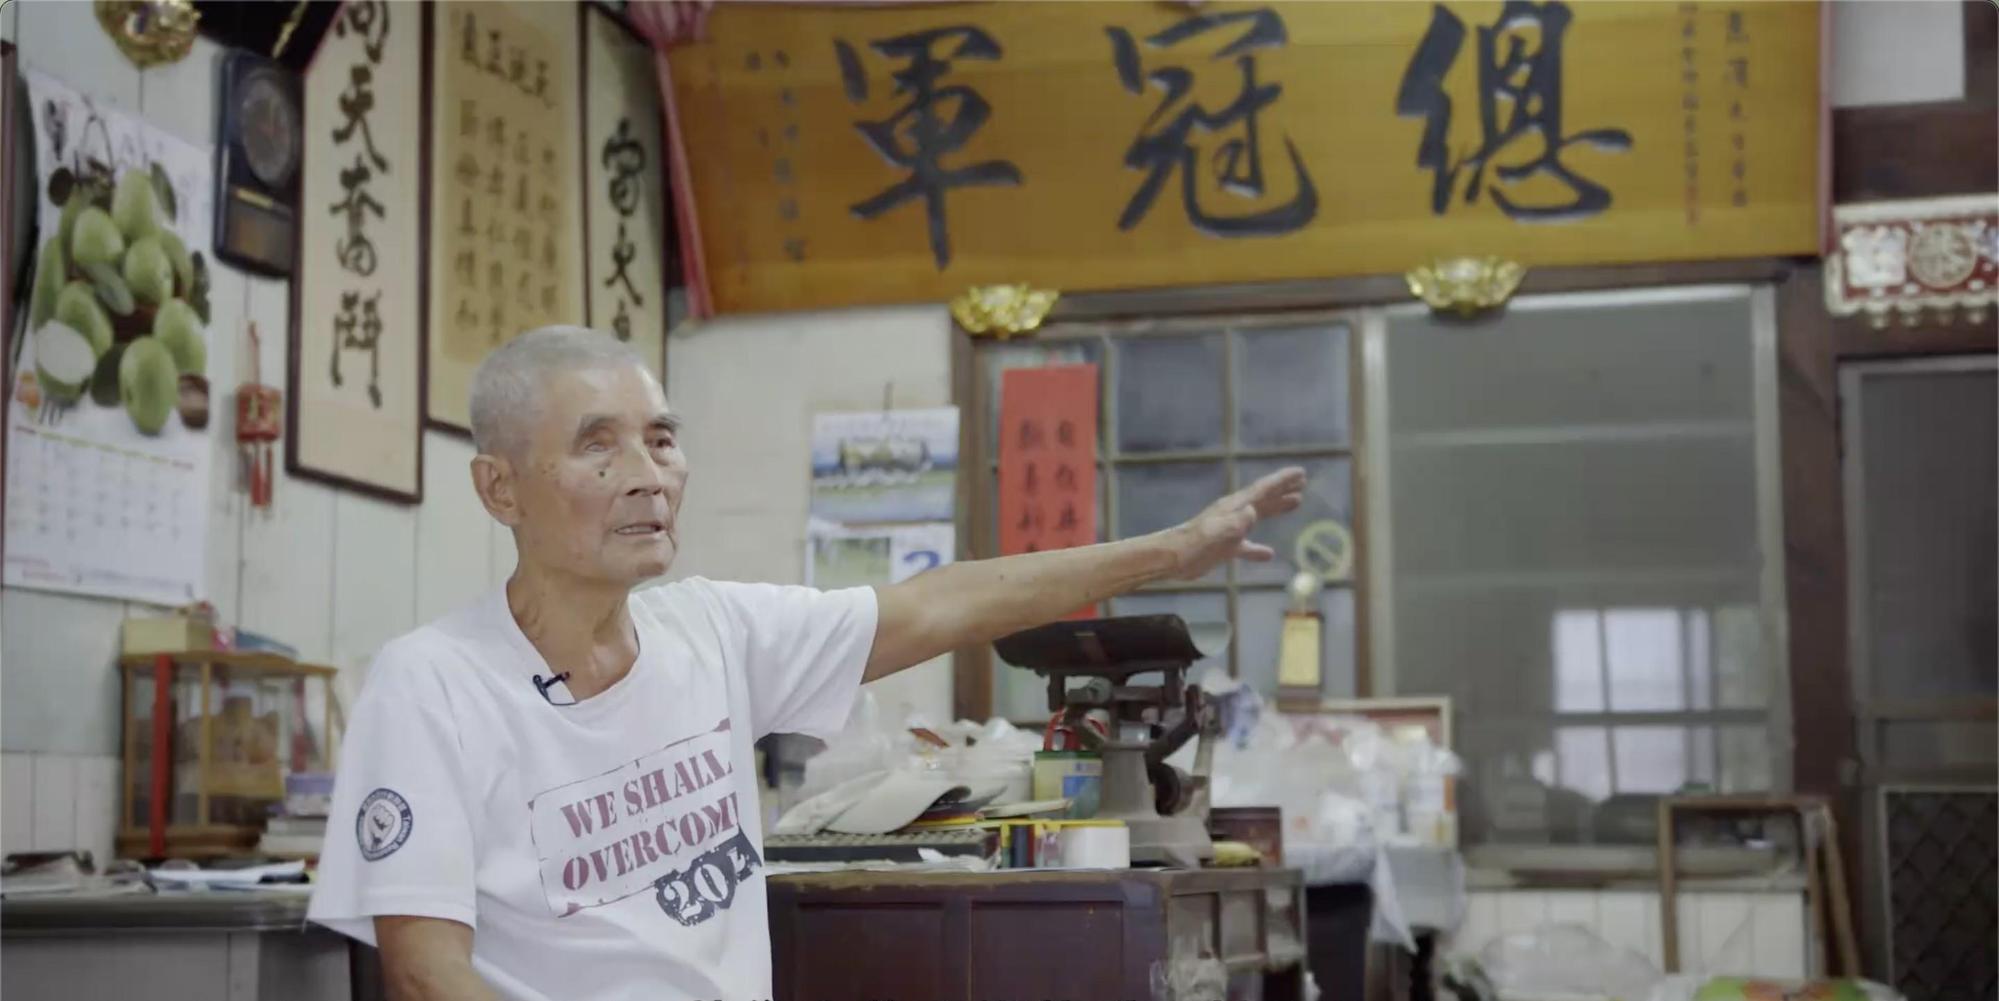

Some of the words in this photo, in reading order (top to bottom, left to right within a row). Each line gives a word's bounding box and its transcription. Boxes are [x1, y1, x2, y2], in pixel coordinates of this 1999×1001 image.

[560, 791, 617, 838] WE
[623, 749, 733, 817] SHALL
[562, 791, 739, 891] OVERCOM
